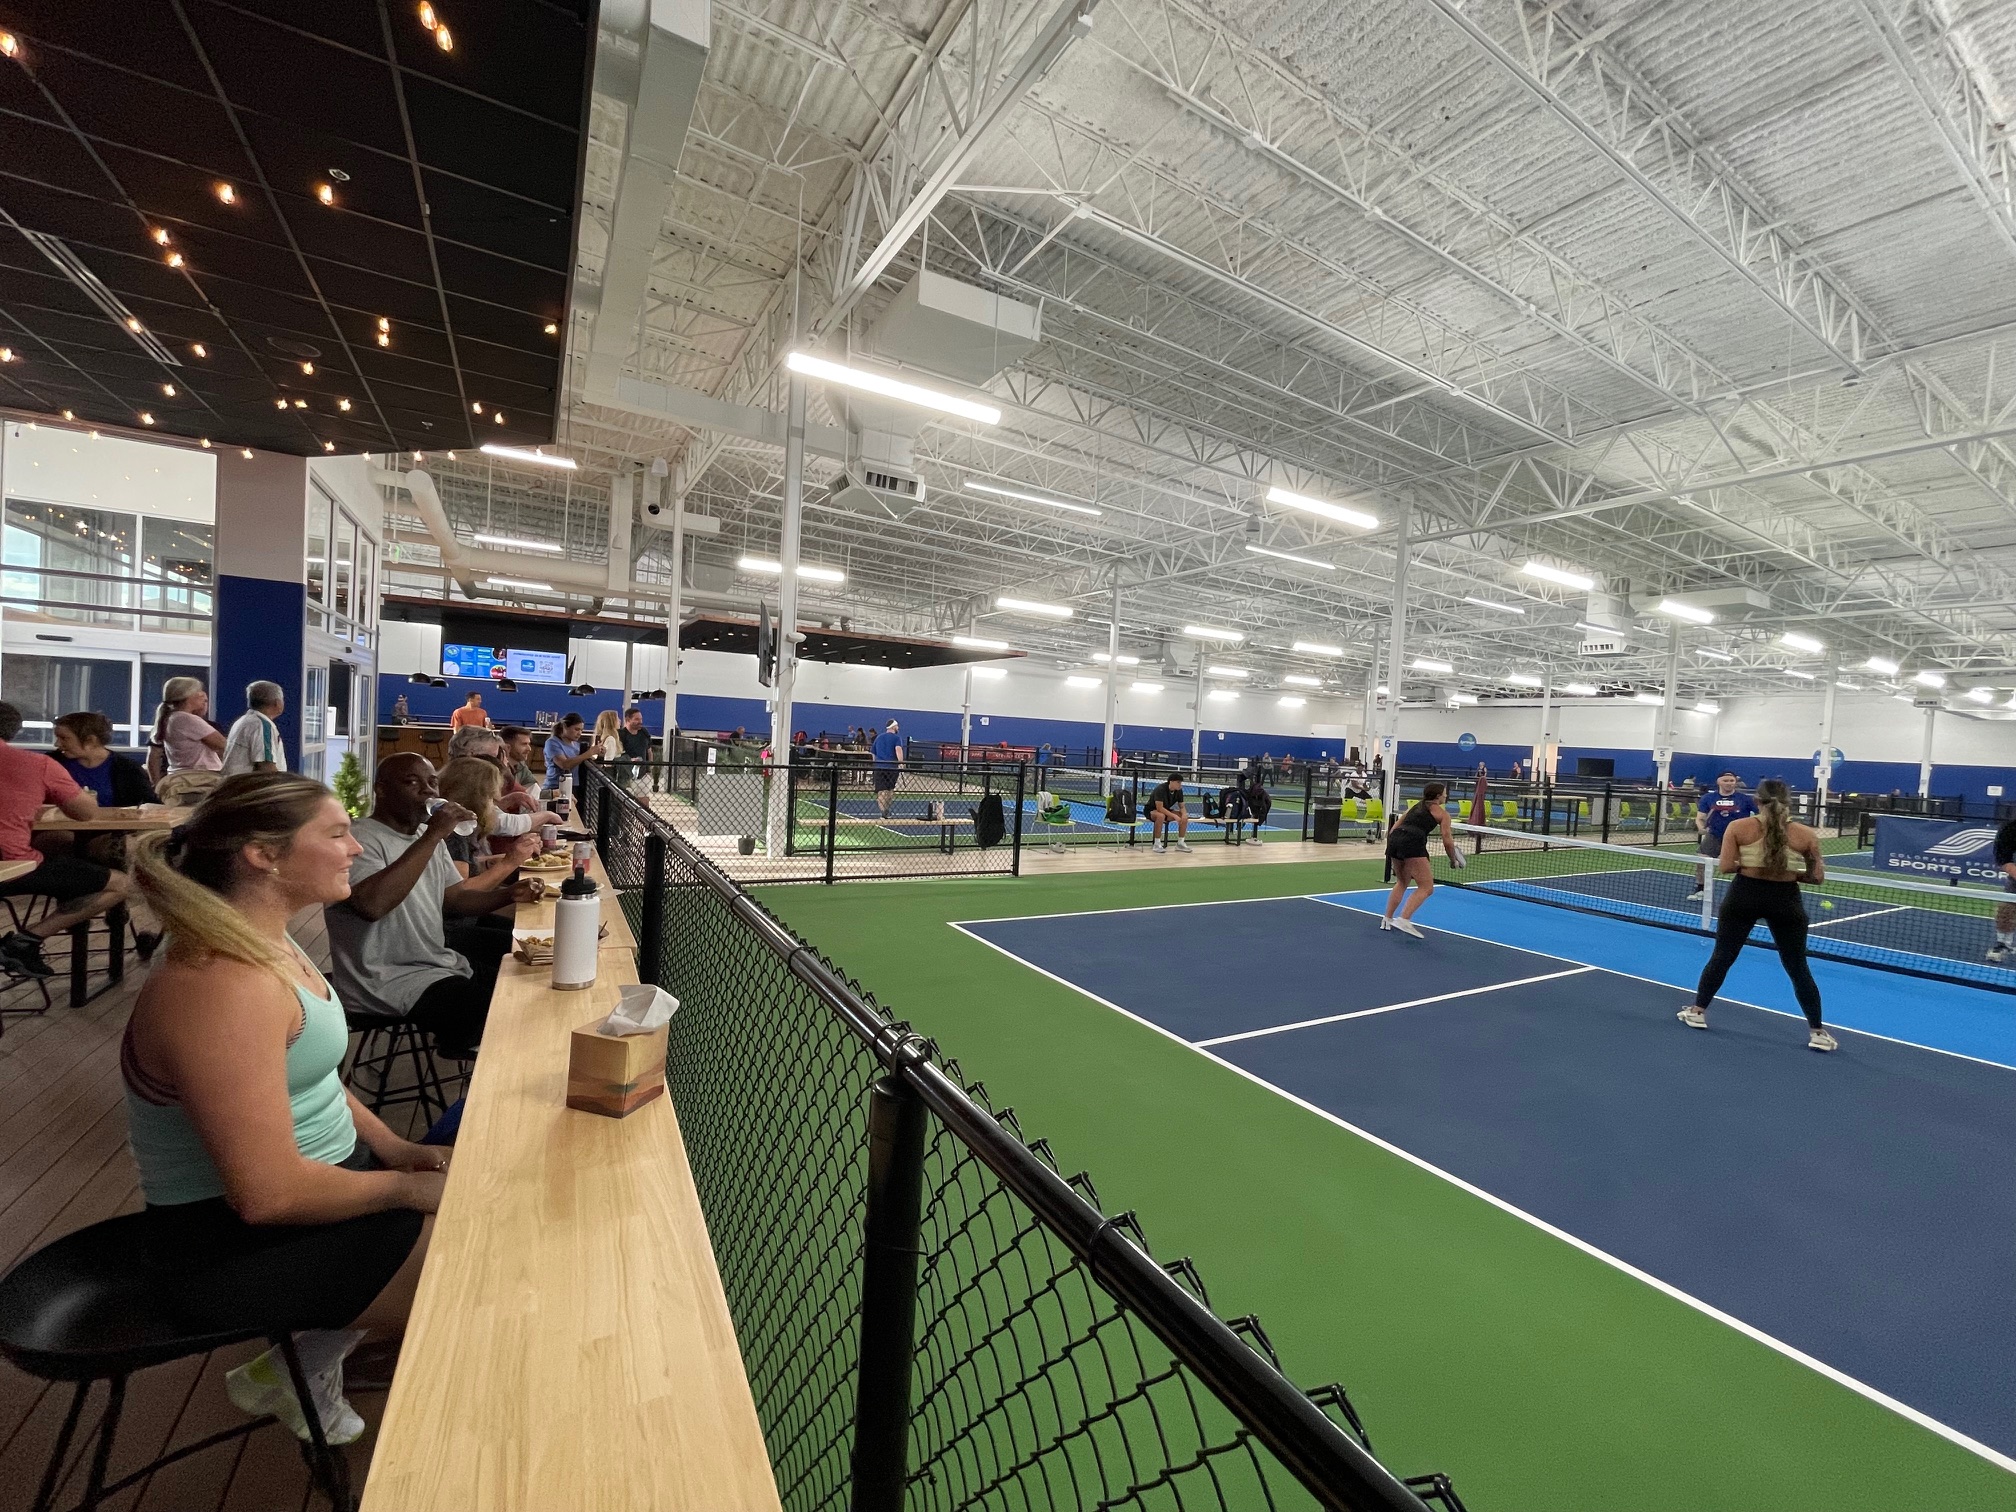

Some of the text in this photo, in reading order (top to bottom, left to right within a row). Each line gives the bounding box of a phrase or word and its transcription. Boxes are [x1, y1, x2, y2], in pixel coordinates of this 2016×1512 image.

[1384, 739, 1391, 748] 6
[1889, 852, 1956, 864] COLORADO
[1888, 858, 2010, 880] SPORTS COR
